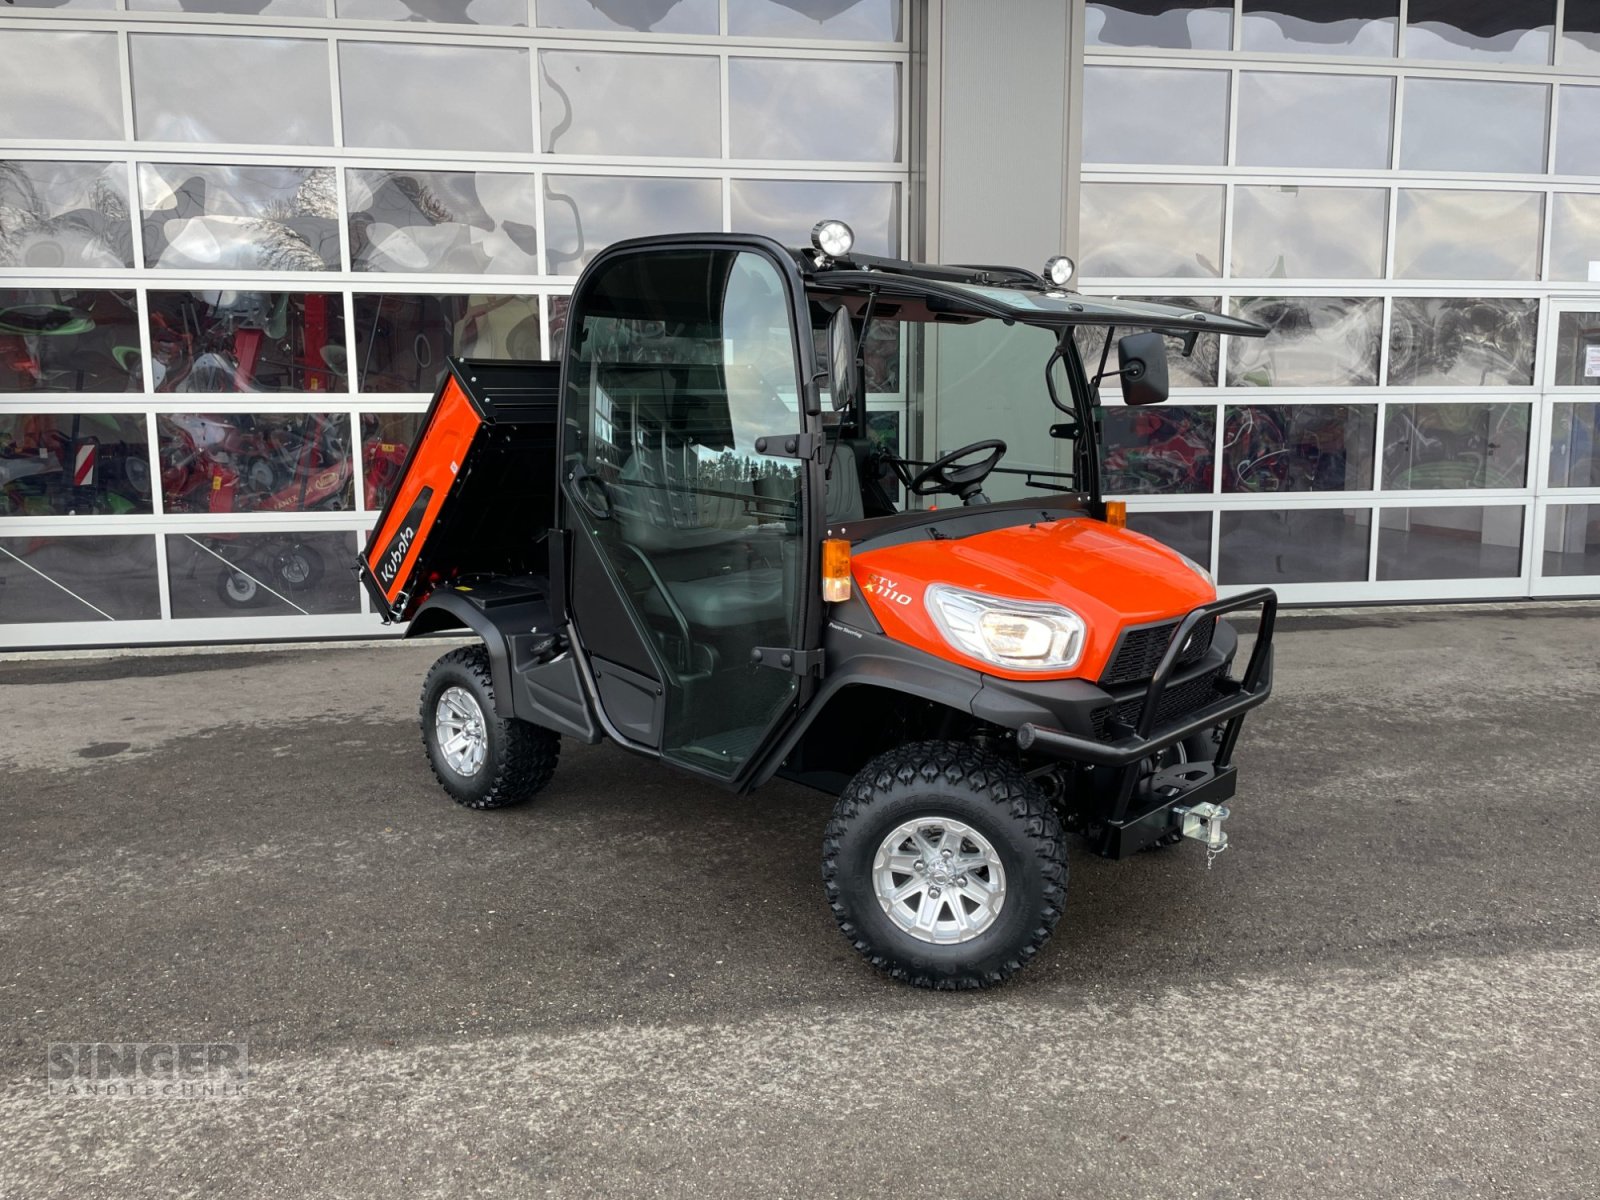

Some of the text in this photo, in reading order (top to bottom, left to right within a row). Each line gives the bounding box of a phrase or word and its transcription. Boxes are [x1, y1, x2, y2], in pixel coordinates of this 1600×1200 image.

[381, 527, 414, 582] Kubota
[864, 582, 912, 605] X1110
[842, 627, 863, 639] Steering
